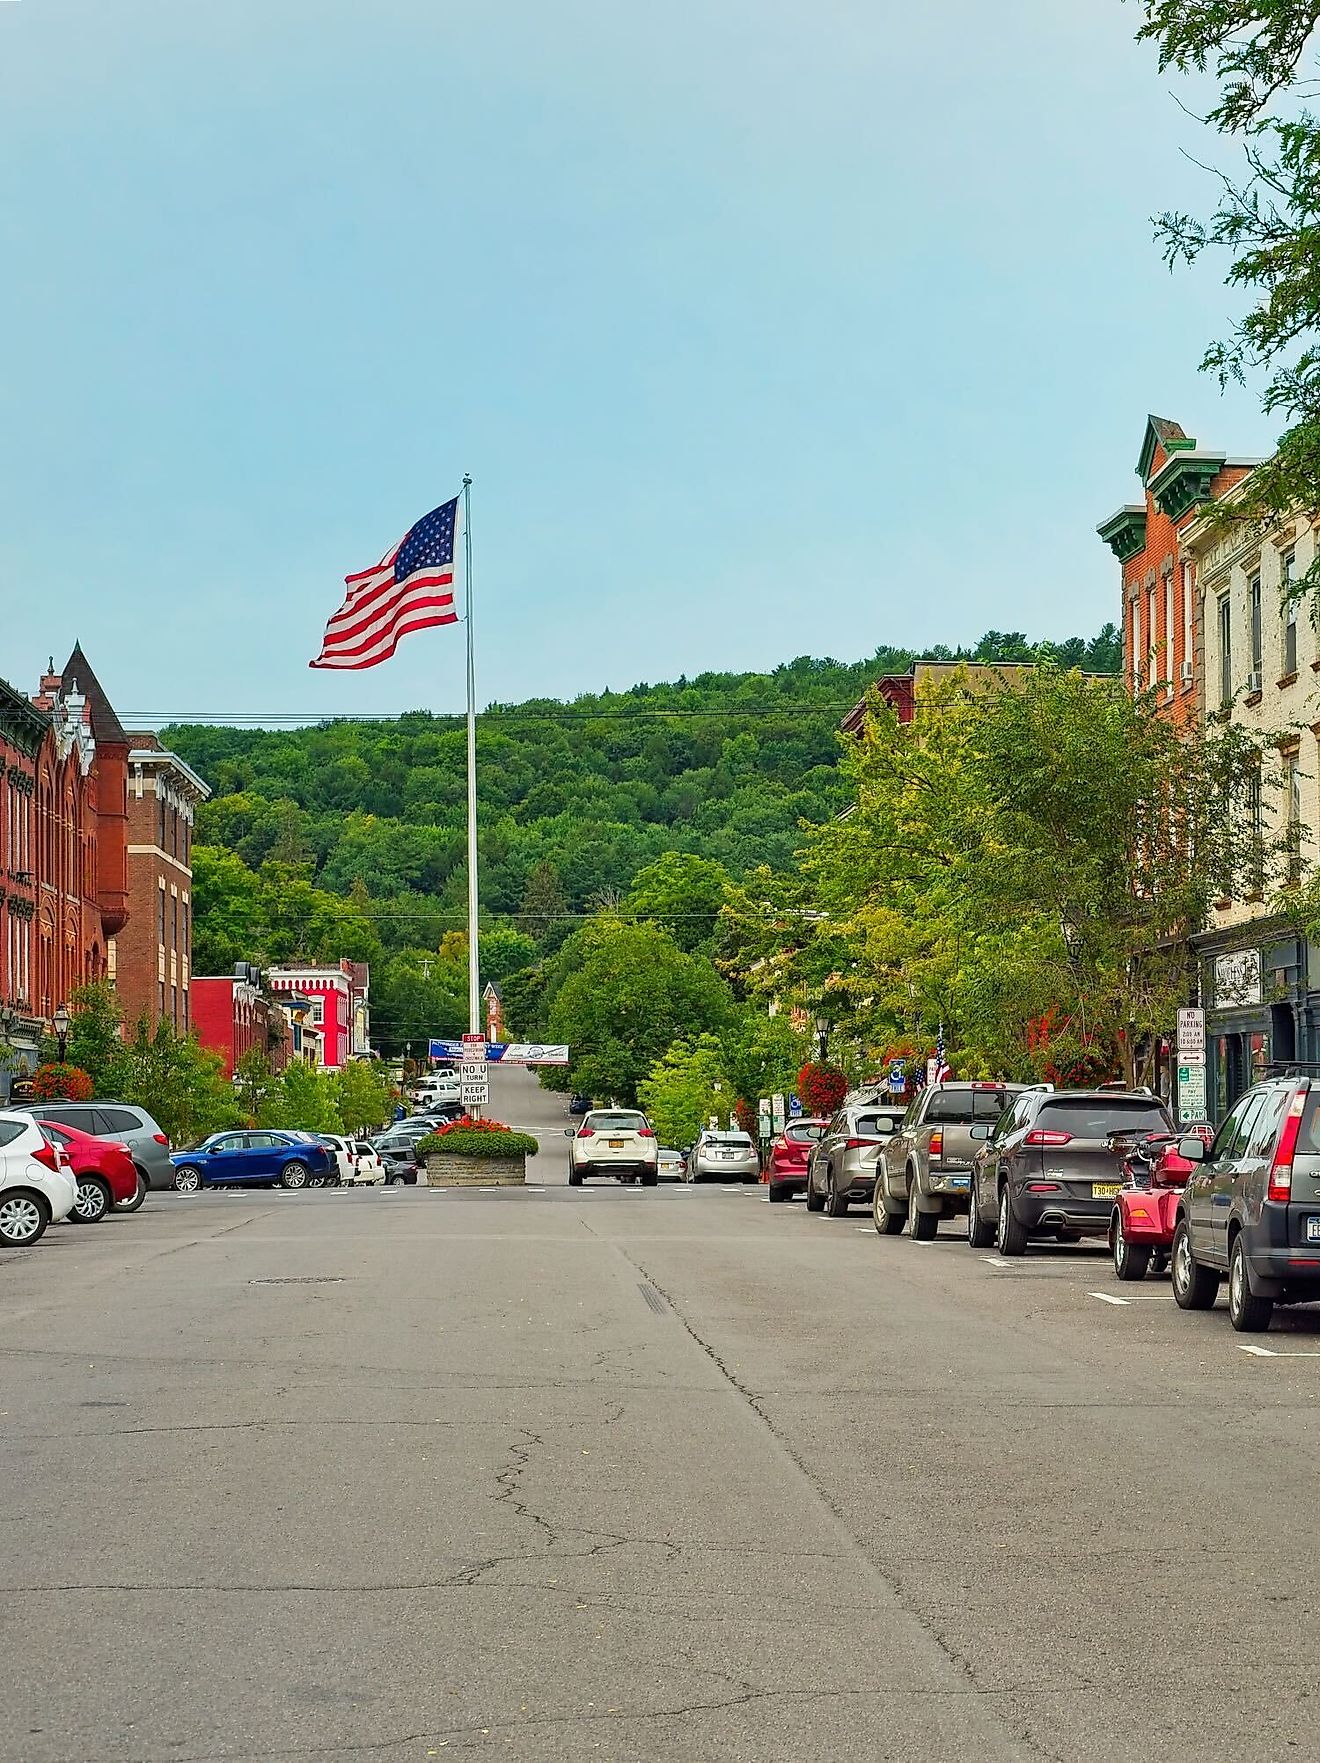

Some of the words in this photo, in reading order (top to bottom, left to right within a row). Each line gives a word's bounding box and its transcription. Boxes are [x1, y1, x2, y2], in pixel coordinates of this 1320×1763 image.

[1186, 1011, 1195, 1019] NO
[1180, 1020, 1203, 1029] PARKING
[462, 1066, 476, 1074] NO
[480, 1065, 487, 1074] U
[464, 1086, 486, 1094] KEEP
[463, 1095, 487, 1103] RIGHT
[1191, 1111, 1204, 1119] PAY
